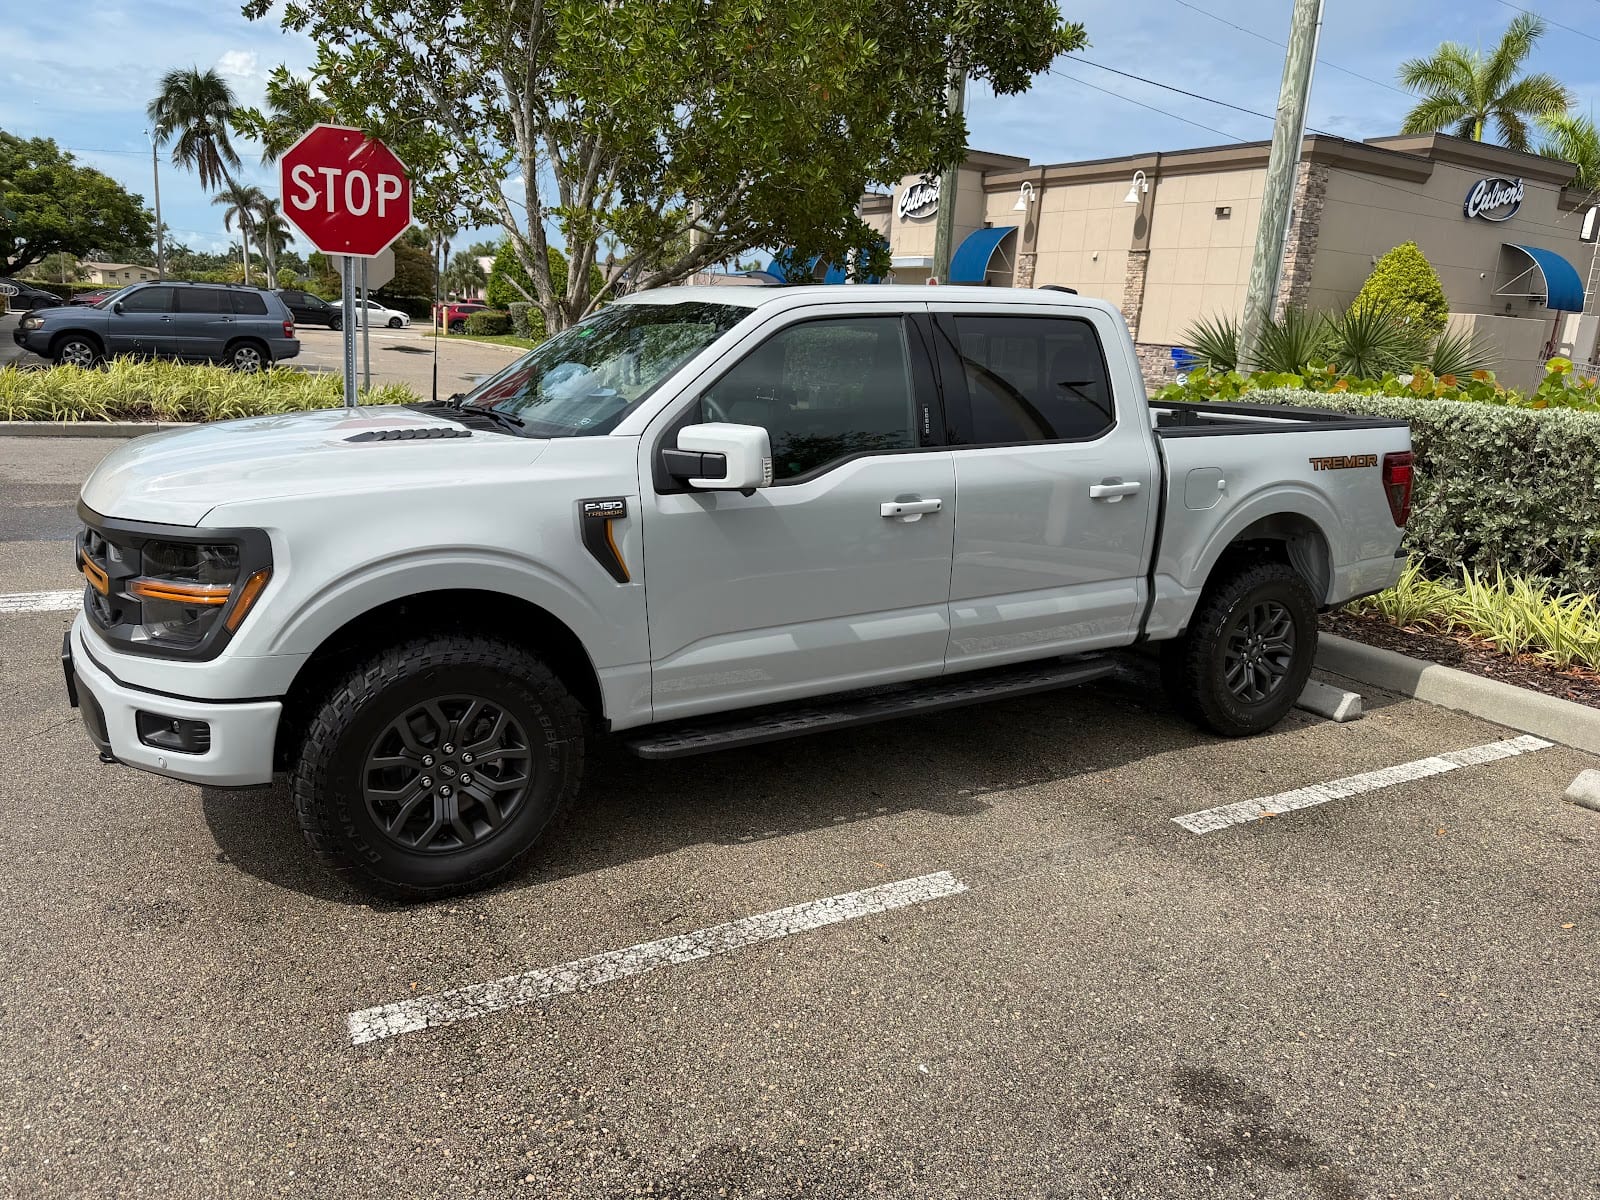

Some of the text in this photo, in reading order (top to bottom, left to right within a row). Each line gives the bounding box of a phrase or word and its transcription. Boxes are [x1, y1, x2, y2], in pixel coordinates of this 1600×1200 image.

[290, 164, 403, 218] STOP
[1467, 178, 1525, 218] Culver's
[1309, 454, 1378, 471] TREMOR
[584, 501, 623, 512] F-150
[333, 770, 383, 864] GENER
